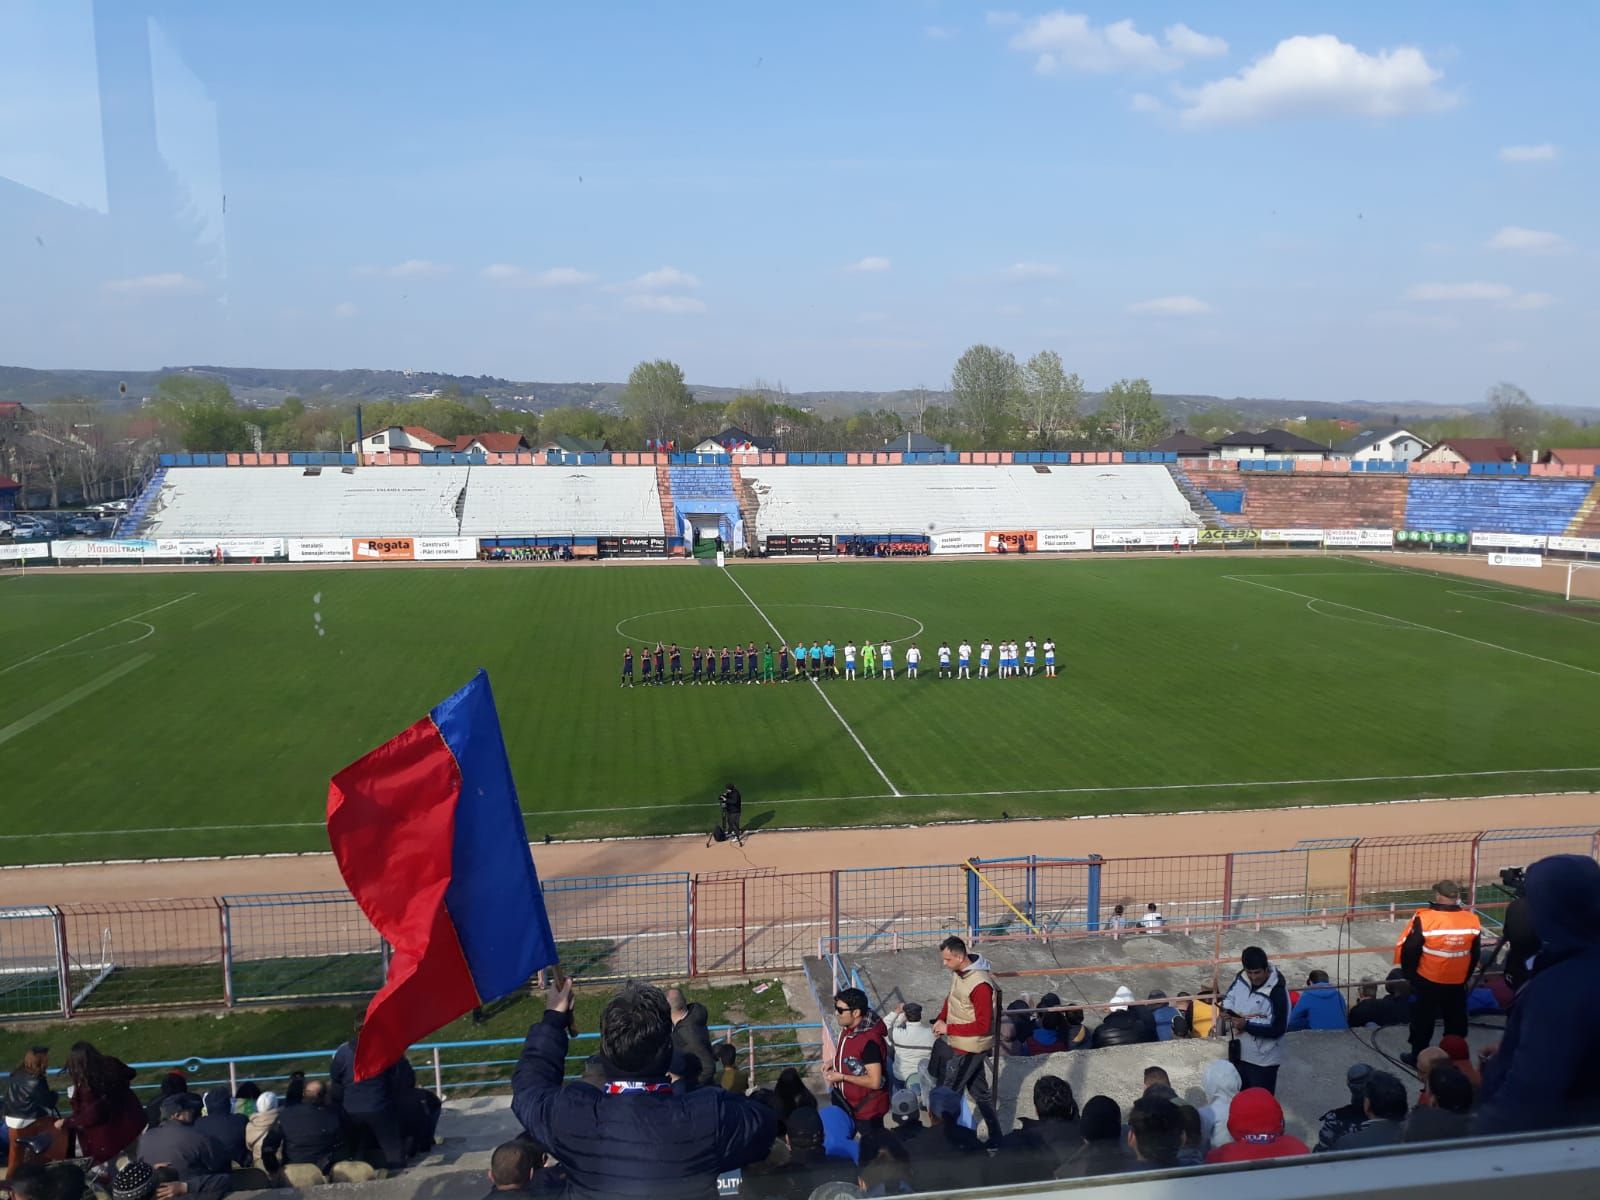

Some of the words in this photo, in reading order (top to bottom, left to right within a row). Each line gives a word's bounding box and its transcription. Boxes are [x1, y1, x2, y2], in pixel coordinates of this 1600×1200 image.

[998, 533, 1034, 544] Regta
[1201, 530, 1258, 539] ACERBIS
[1397, 530, 1466, 543] UNIBET
[368, 540, 410, 552] Regata
[651, 538, 665, 546] PRO
